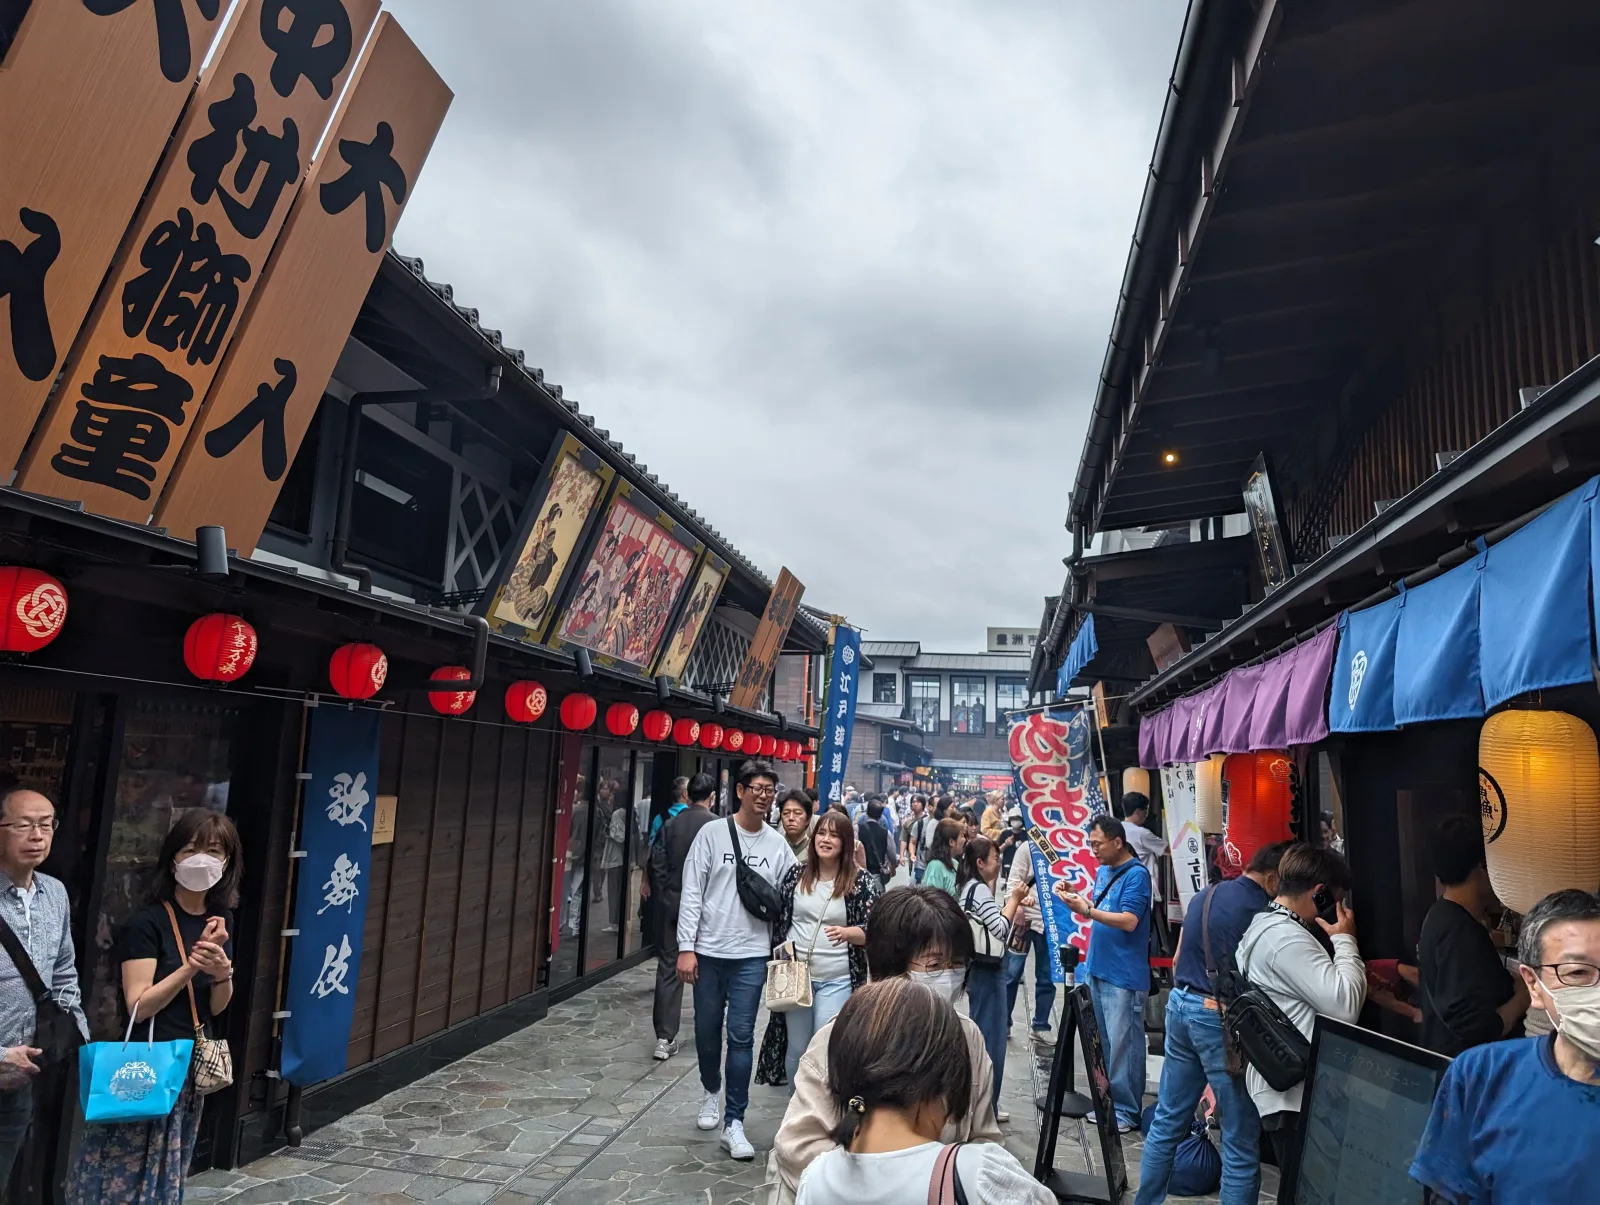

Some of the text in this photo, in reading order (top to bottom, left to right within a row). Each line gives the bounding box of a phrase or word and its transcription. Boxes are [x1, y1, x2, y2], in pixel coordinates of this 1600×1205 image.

[51, 0, 352, 500] 中村獅童
[204, 122, 407, 482] 大入
[309, 771, 370, 999] 歌舞伎
[723, 853, 769, 868] RCA
[1331, 1047, 1421, 1087] テイクアウトメニュー
